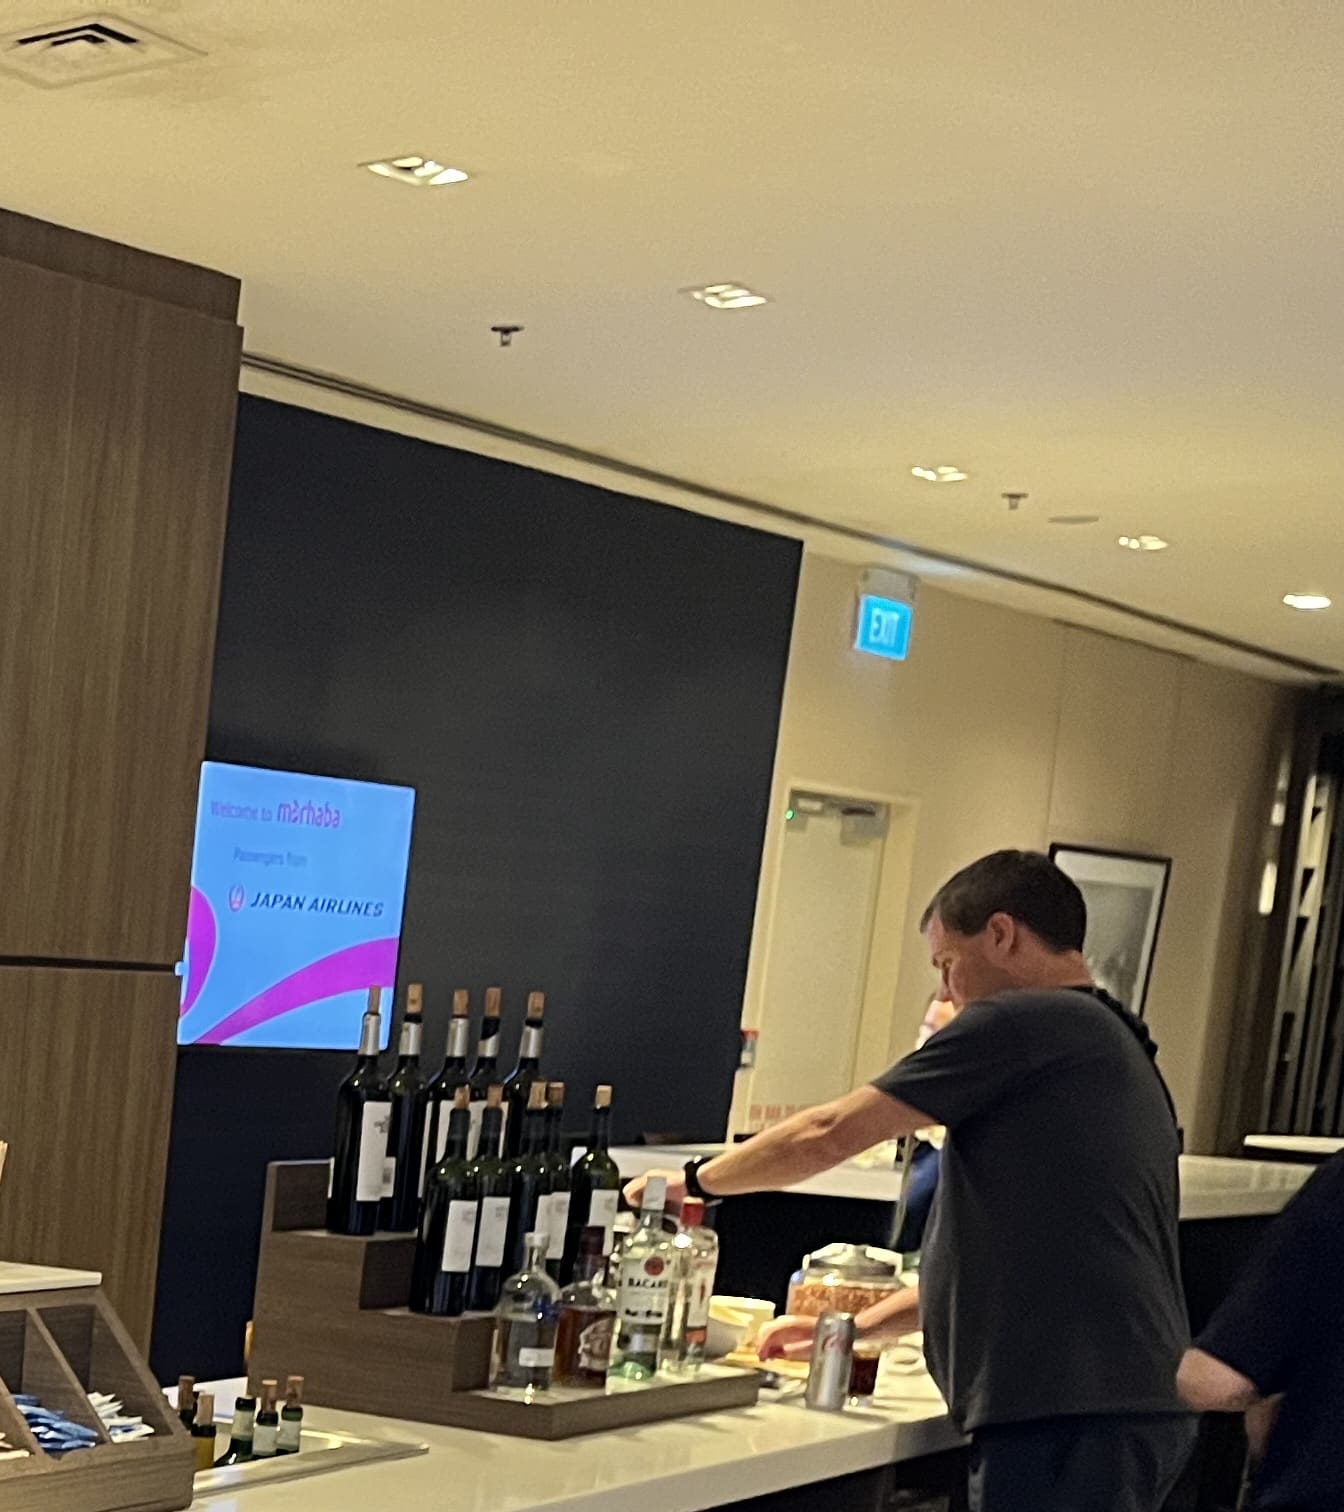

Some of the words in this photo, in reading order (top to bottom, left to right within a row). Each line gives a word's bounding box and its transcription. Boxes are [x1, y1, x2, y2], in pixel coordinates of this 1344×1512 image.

[261, 807, 273, 822] to
[250, 891, 307, 911] JAPAN
[308, 896, 385, 918] AIRLINES
